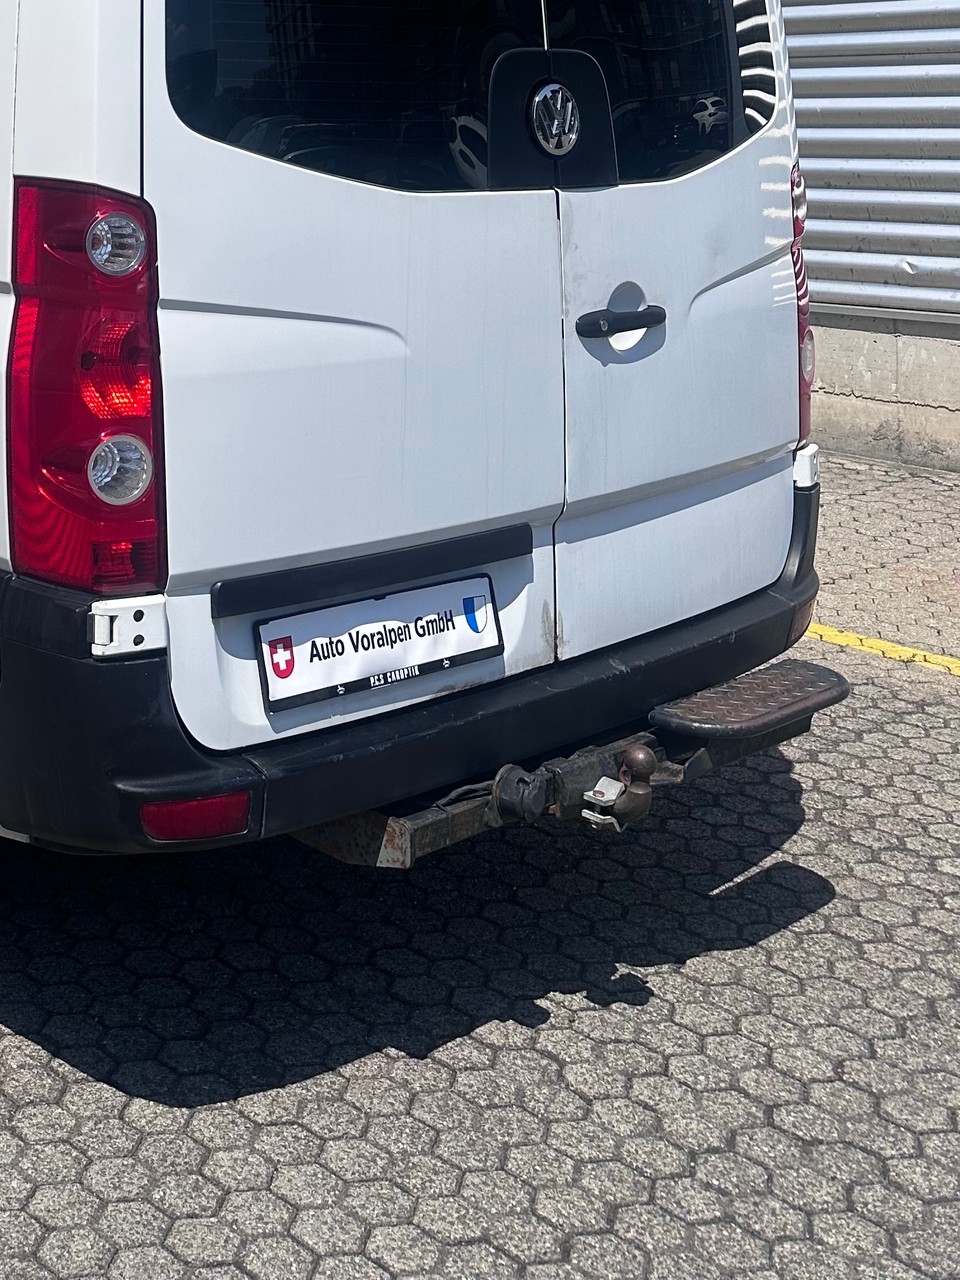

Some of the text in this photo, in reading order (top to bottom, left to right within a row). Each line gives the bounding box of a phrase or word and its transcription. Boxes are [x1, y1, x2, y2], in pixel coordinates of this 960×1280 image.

[309, 609, 456, 663] Auto Voralpen GmbH
